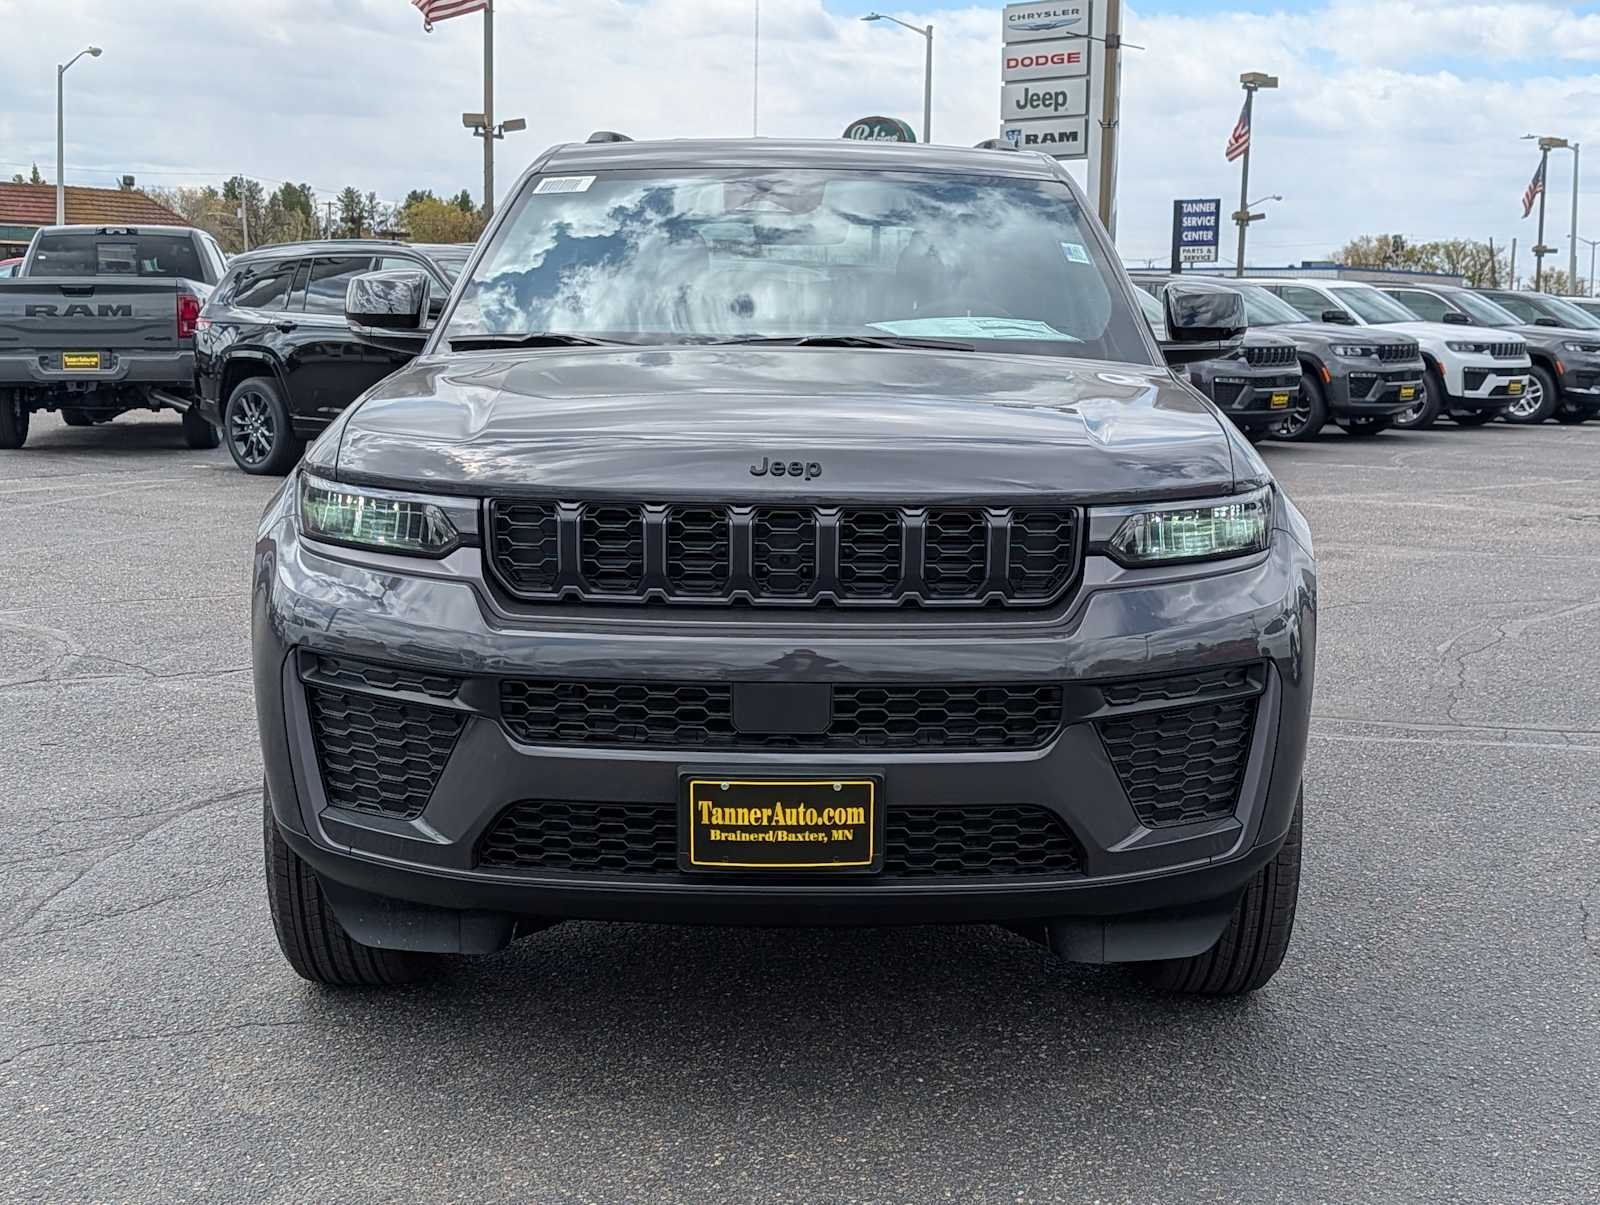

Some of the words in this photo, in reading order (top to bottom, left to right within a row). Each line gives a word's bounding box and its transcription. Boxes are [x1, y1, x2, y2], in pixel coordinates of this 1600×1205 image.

[1009, 8, 1080, 21] CHRYSLER
[1006, 52, 1081, 69] DODGE
[1016, 87, 1068, 112] Jeep
[1025, 131, 1079, 145] RAM
[1182, 202, 1216, 213] TANNER
[1182, 216, 1215, 227] SERVICE
[1182, 230, 1214, 241] CENTER
[25, 304, 132, 317] RAM
[749, 456, 822, 481] Jeep
[699, 801, 866, 826] TannerAuto.com
[710, 829, 828, 843] Brainerd/Baxter,
[831, 829, 854, 841] MN
